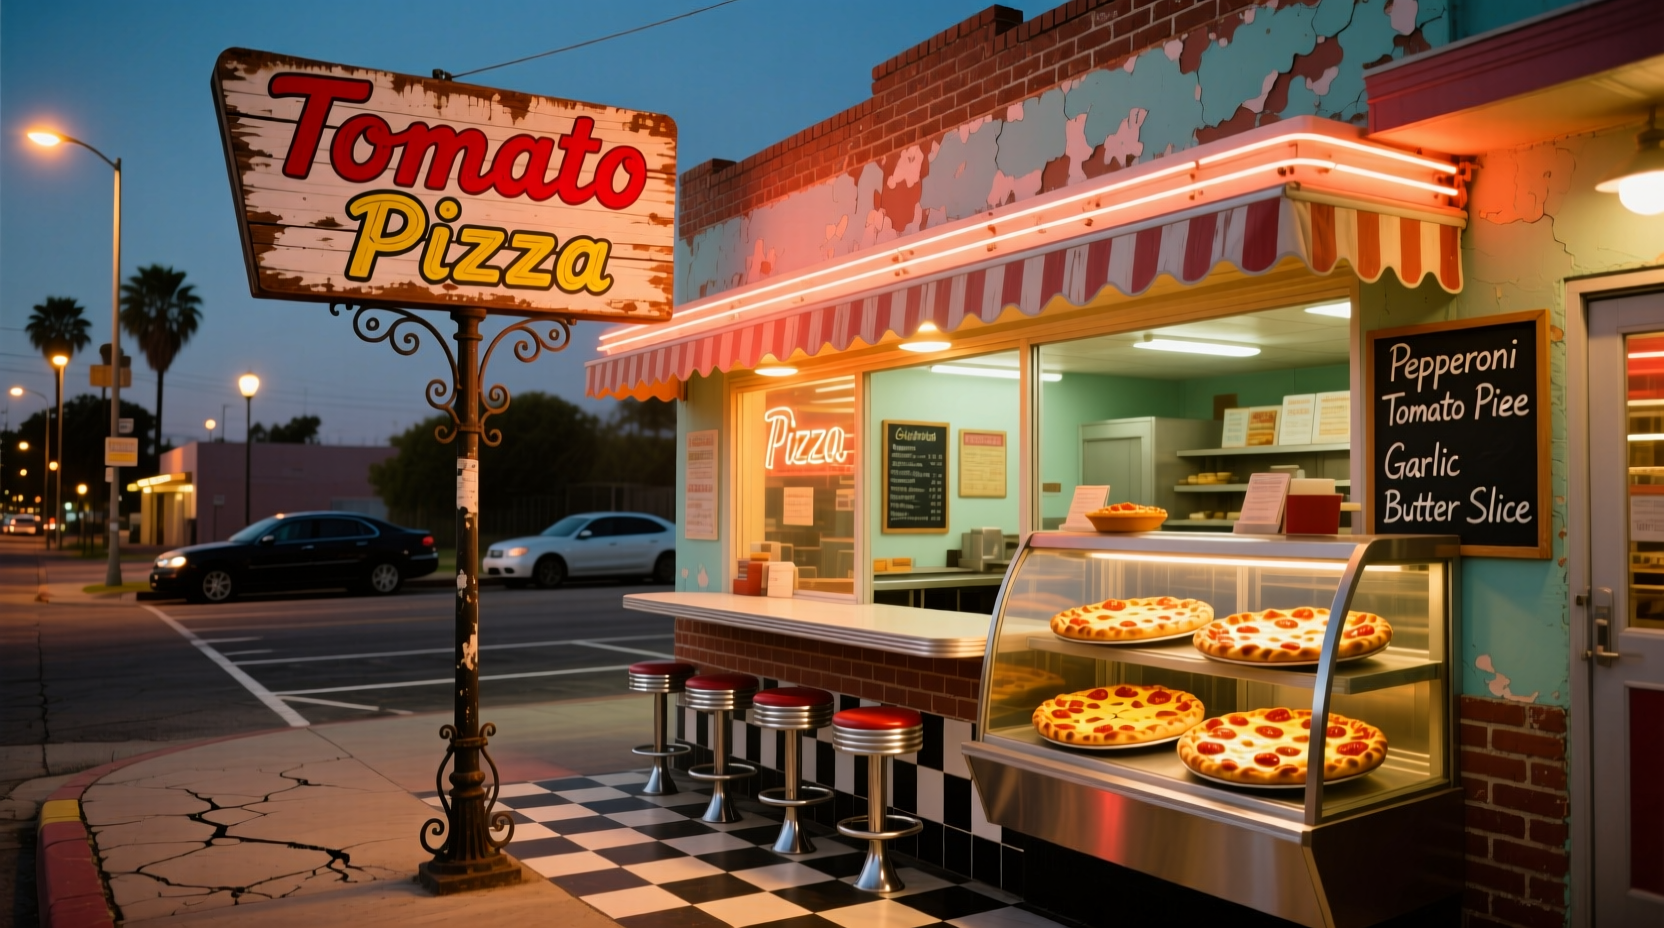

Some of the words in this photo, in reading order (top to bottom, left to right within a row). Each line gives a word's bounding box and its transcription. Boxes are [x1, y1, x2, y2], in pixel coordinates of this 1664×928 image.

[268, 72, 647, 210] Tomato
[344, 189, 614, 296] Pizza
[1389, 338, 1518, 393] Pepperoni
[1381, 391, 1465, 427] Tomato
[1474, 382, 1530, 420] Piee
[764, 406, 848, 470] Pizza
[1384, 441, 1461, 480] Garlic
[1383, 489, 1461, 524] Butter
[1466, 486, 1532, 524] Slice
